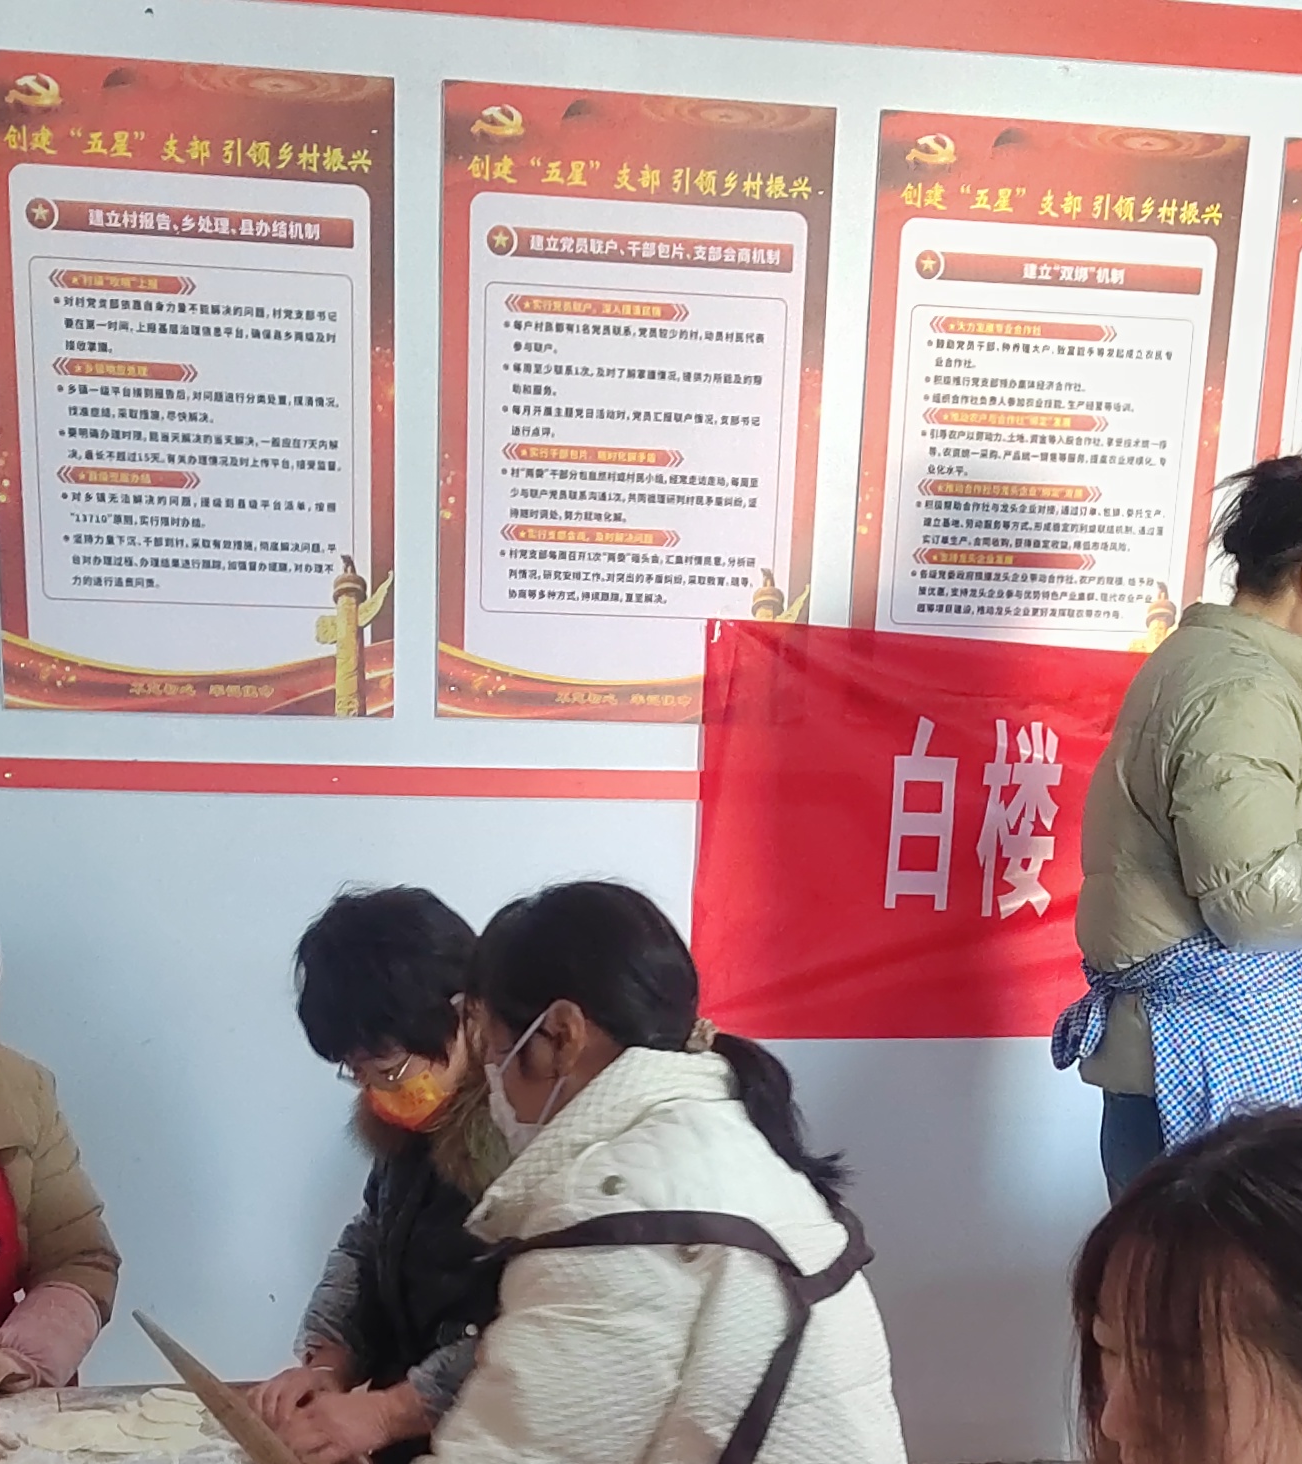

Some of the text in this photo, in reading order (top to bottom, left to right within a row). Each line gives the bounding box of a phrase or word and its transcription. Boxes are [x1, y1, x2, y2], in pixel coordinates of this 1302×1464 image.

[223, 140, 372, 174] 引领乡村振兴
[672, 169, 813, 200] 引领乡村振兴
[88, 209, 320, 241] 建立村报告、乡处理、县办结机制
[1092, 192, 1223, 226] 引领乡村振兴
